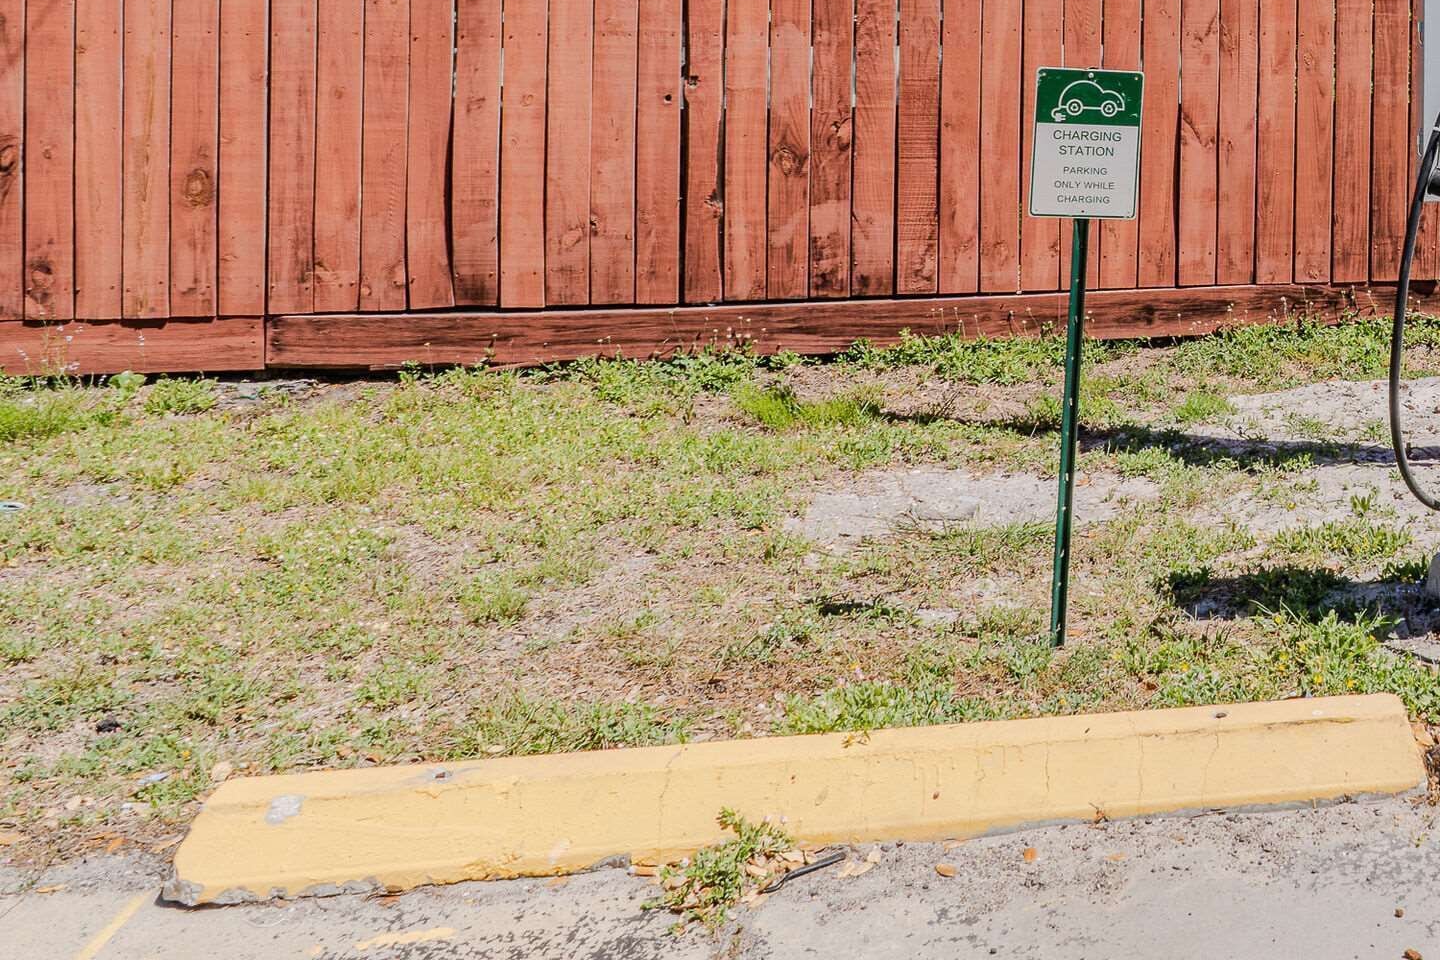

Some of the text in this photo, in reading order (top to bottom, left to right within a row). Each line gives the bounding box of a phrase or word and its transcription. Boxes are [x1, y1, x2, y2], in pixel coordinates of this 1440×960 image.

[1053, 129, 1122, 142] CHARGING
[1059, 145, 1115, 157] STATION
[1063, 166, 1108, 175] PARKING
[1054, 180, 1115, 190] ONLY WHILE
[1057, 195, 1110, 204] CHARGING
